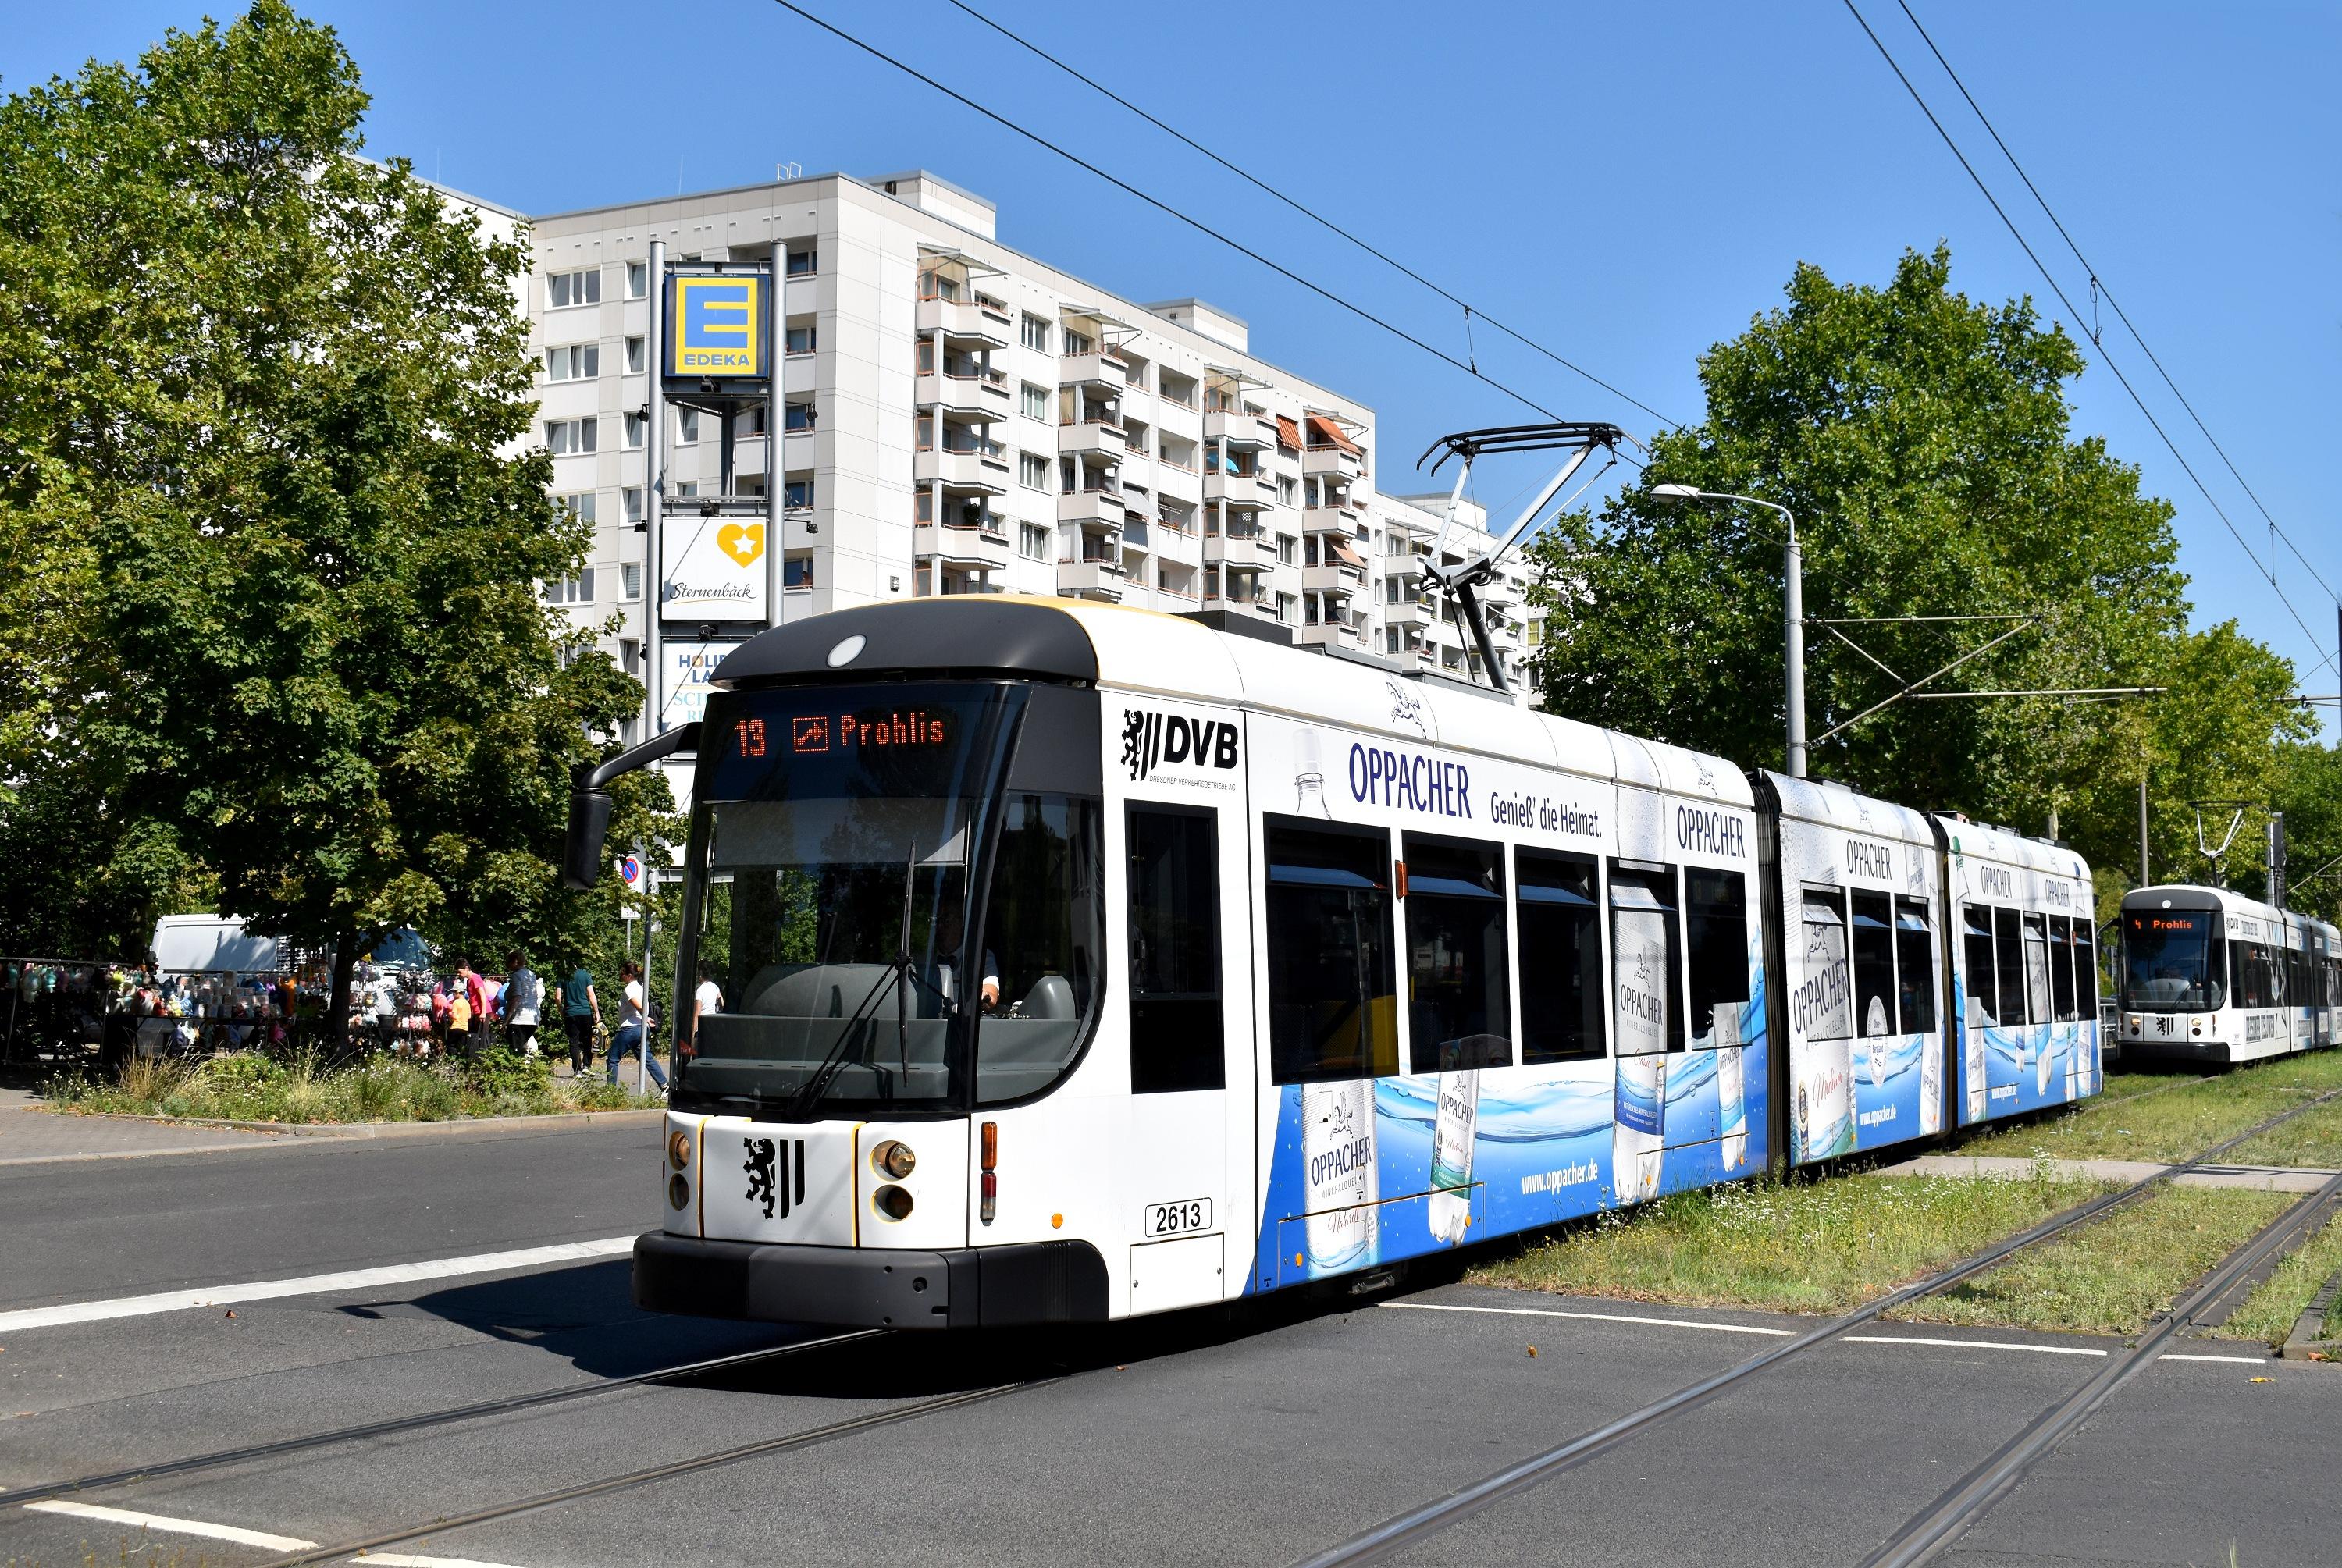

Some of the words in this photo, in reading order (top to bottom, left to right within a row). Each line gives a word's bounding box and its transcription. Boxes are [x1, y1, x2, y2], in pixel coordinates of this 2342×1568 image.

[684, 354, 750, 366] EDEKA
[670, 582, 758, 599] Sternenbäck
[735, 720, 766, 756] 13
[841, 712, 944, 745] Prohlis
[1163, 714, 1239, 770] DVB
[1149, 775, 1178, 785] DRESDNER
[1178, 778, 1228, 791] VERKEHRSBETRIEBE
[1228, 783, 1237, 791] AG
[1349, 742, 1472, 819] OPPACHER
[1540, 797, 1557, 831] die
[1561, 802, 1602, 837] Heimat.
[1677, 805, 1746, 858] OPPACHER
[1846, 838, 1892, 880] OPPACHER
[1981, 866, 2013, 898] OPPACHER
[2045, 879, 2070, 907] OPPACHER
[2134, 919, 2141, 930] 4
[2153, 919, 2193, 929] Prohlis
[1620, 983, 1663, 1026] OPPACHER
[1793, 958, 1849, 1035] OPPACHER
[1440, 1092, 1474, 1125] OPPACHER
[1311, 1136, 1372, 1186] OPPACHER
[1522, 1157, 1598, 1195] www.oppacher.de
[1156, 1203, 1201, 1232] 2613
